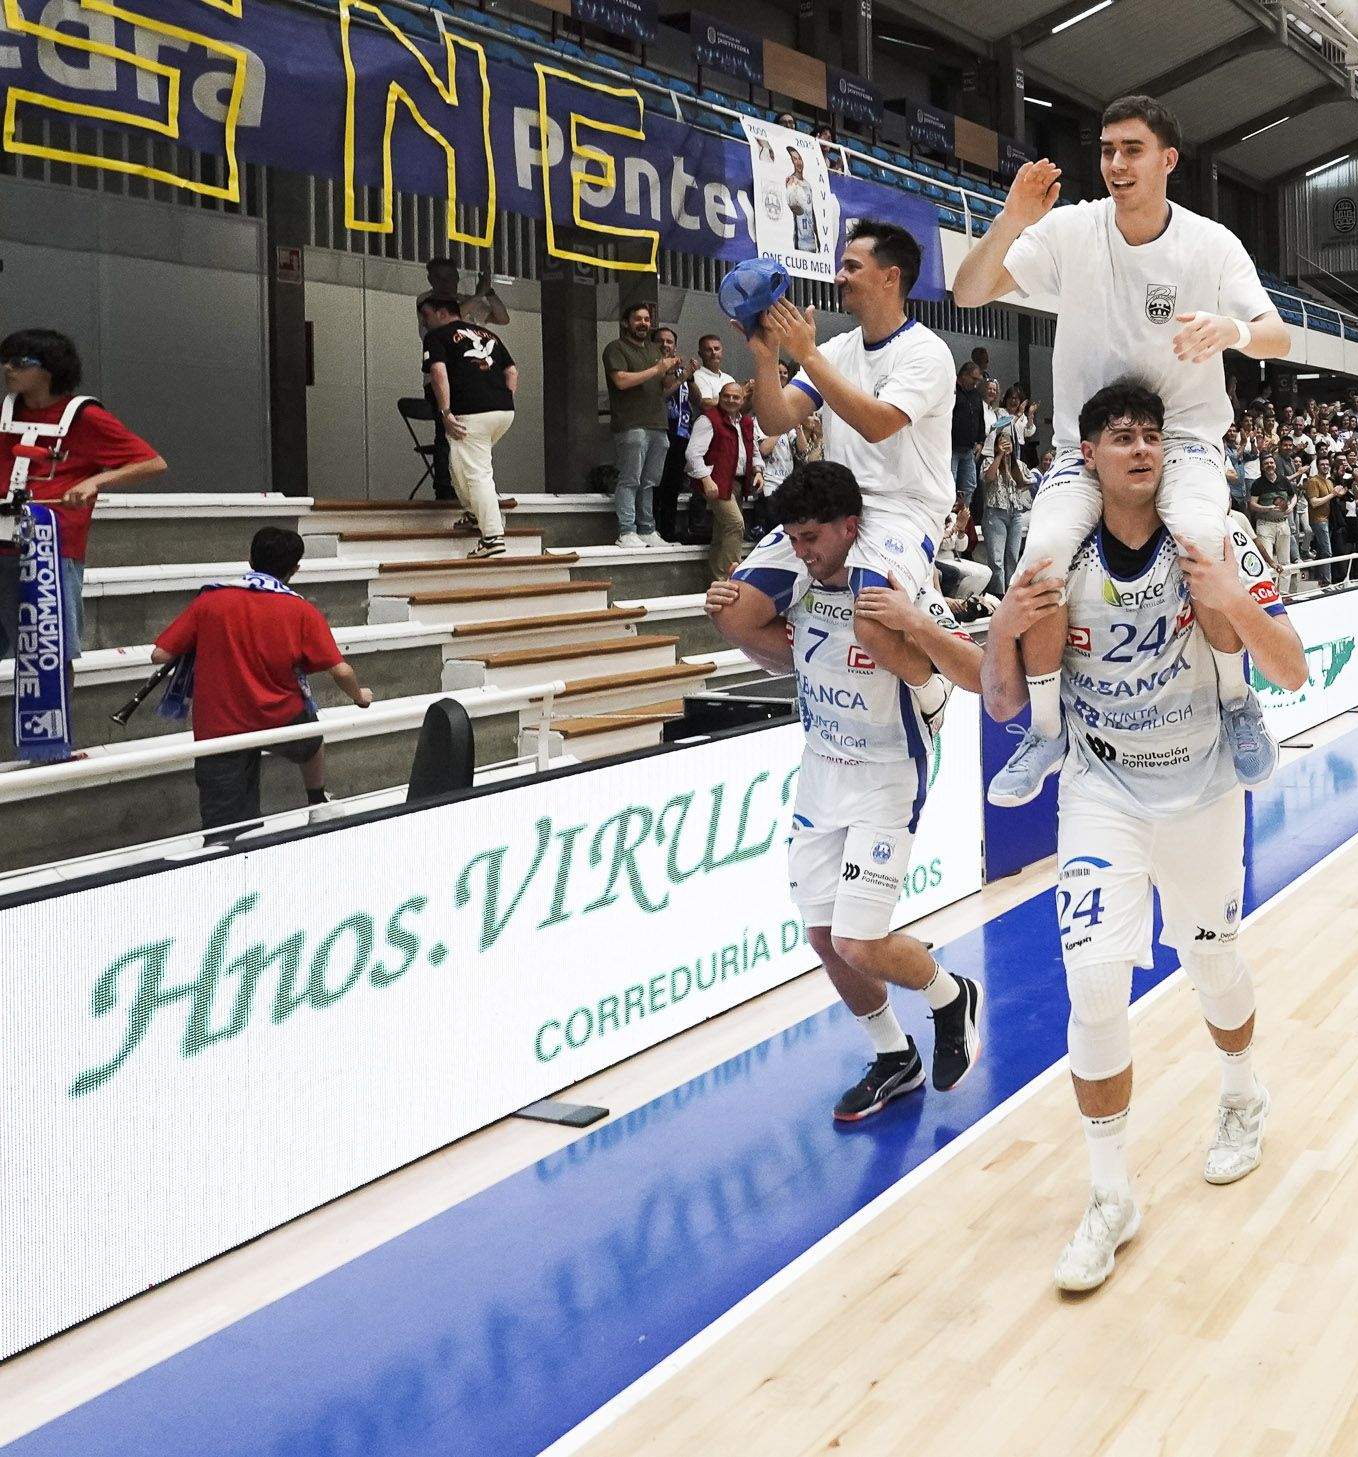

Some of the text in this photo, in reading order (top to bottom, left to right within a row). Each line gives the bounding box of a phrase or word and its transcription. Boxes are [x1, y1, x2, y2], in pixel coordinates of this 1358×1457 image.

[785, 254, 808, 271] CLUB
[810, 260, 831, 275] MEN
[814, 601, 853, 621] ence
[805, 627, 829, 663] 7
[1102, 615, 1167, 662] 24
[802, 675, 868, 711] BANCA
[1103, 705, 1159, 723] XUNTA
[534, 926, 772, 1064] CORREDURÍA
